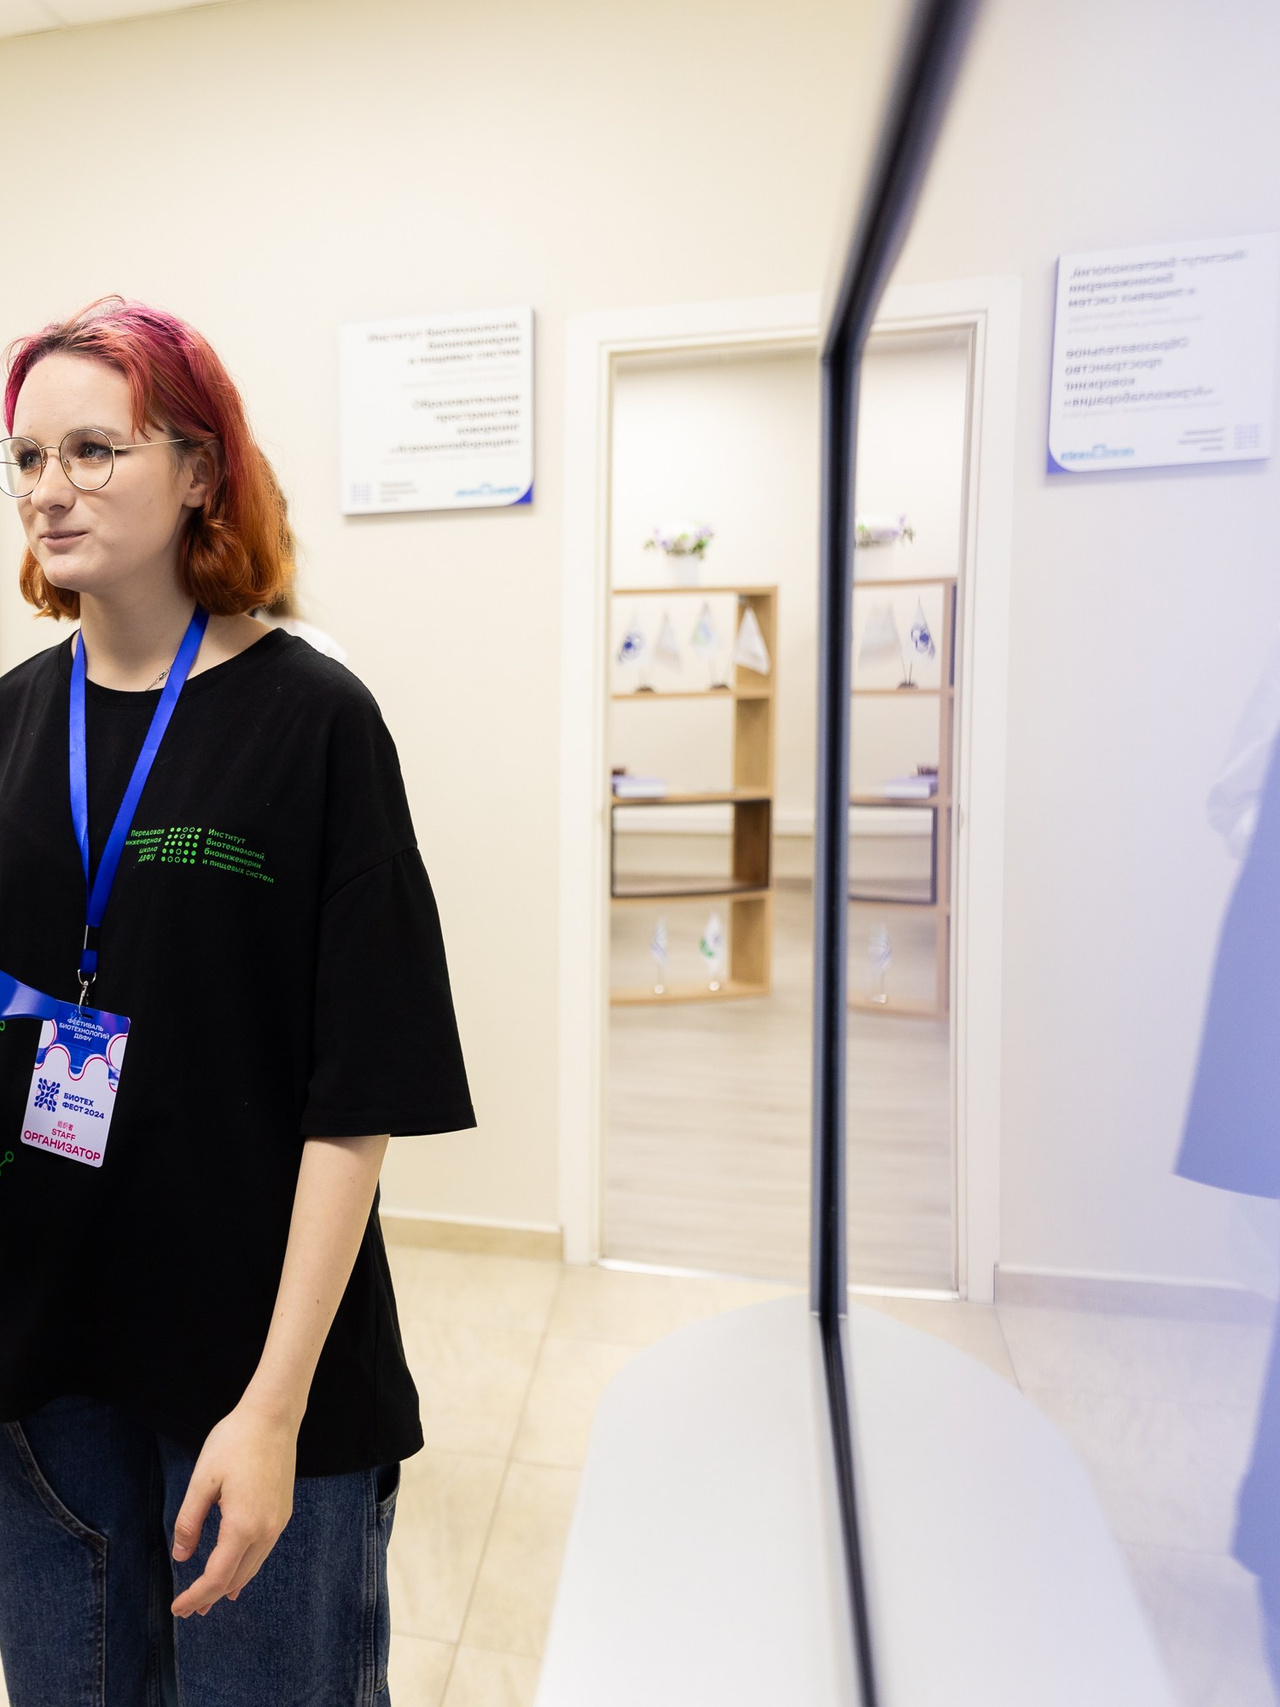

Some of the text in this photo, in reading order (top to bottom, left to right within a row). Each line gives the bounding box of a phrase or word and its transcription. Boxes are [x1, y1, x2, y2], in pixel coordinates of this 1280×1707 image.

[131, 829, 165, 837] Передовая
[208, 828, 246, 844] Институт
[125, 837, 162, 846] инженерная
[206, 837, 266, 861] биотехнологий,
[204, 847, 261, 869] биоинженерии
[210, 860, 244, 874] пищевых
[245, 870, 274, 884] систем
[59, 1022, 110, 1040] БИОТЕХНОЛОГИЙ
[67, 1018, 104, 1032] ФЕСТИВАЛЬ
[73, 1032, 92, 1042] ДВФУ
[63, 1092, 94, 1107] БИОТЕХ
[62, 1101, 105, 1120] ФЕСТ 2024
[51, 1128, 76, 1141] STAFF
[23, 1130, 101, 1162] ОРГАНИЗАТОР
